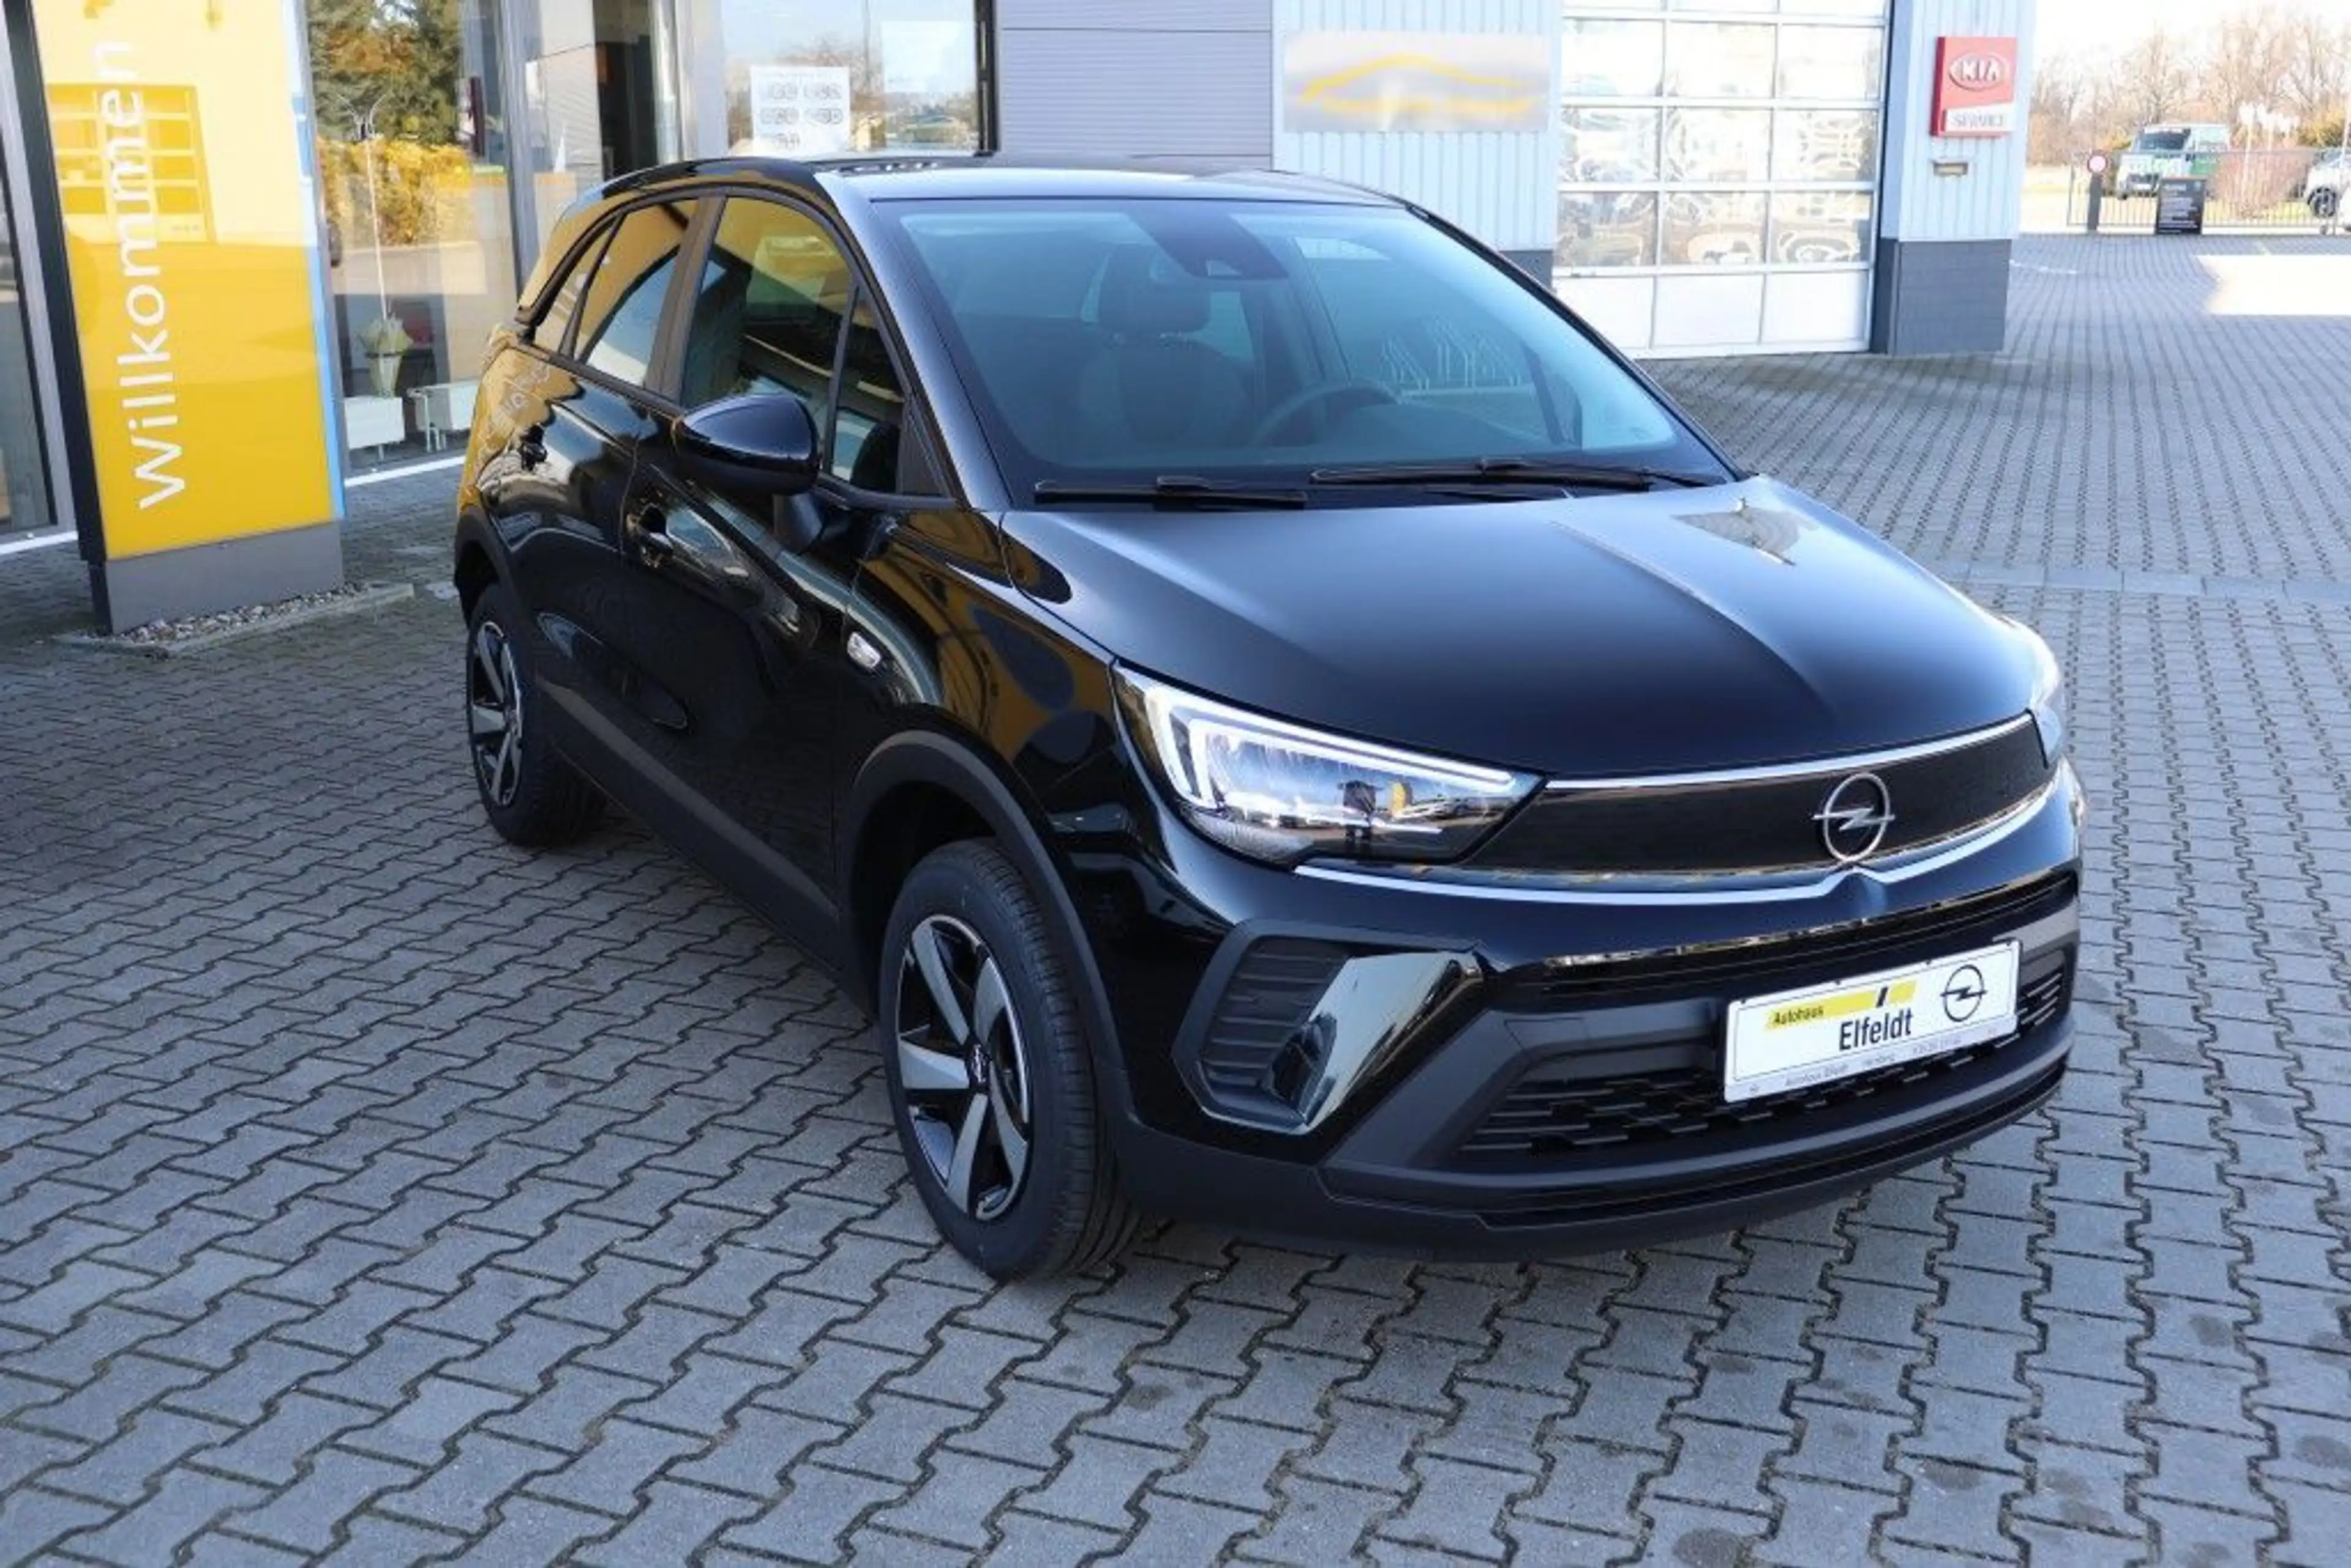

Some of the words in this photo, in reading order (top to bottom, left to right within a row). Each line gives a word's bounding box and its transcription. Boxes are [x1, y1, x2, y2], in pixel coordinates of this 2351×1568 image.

[1961, 59, 2001, 82] KIA
[92, 42, 185, 510] Willkommen
[1773, 1006, 1824, 1025] Autohaus
[1839, 1007, 1913, 1051] Elfeldt
